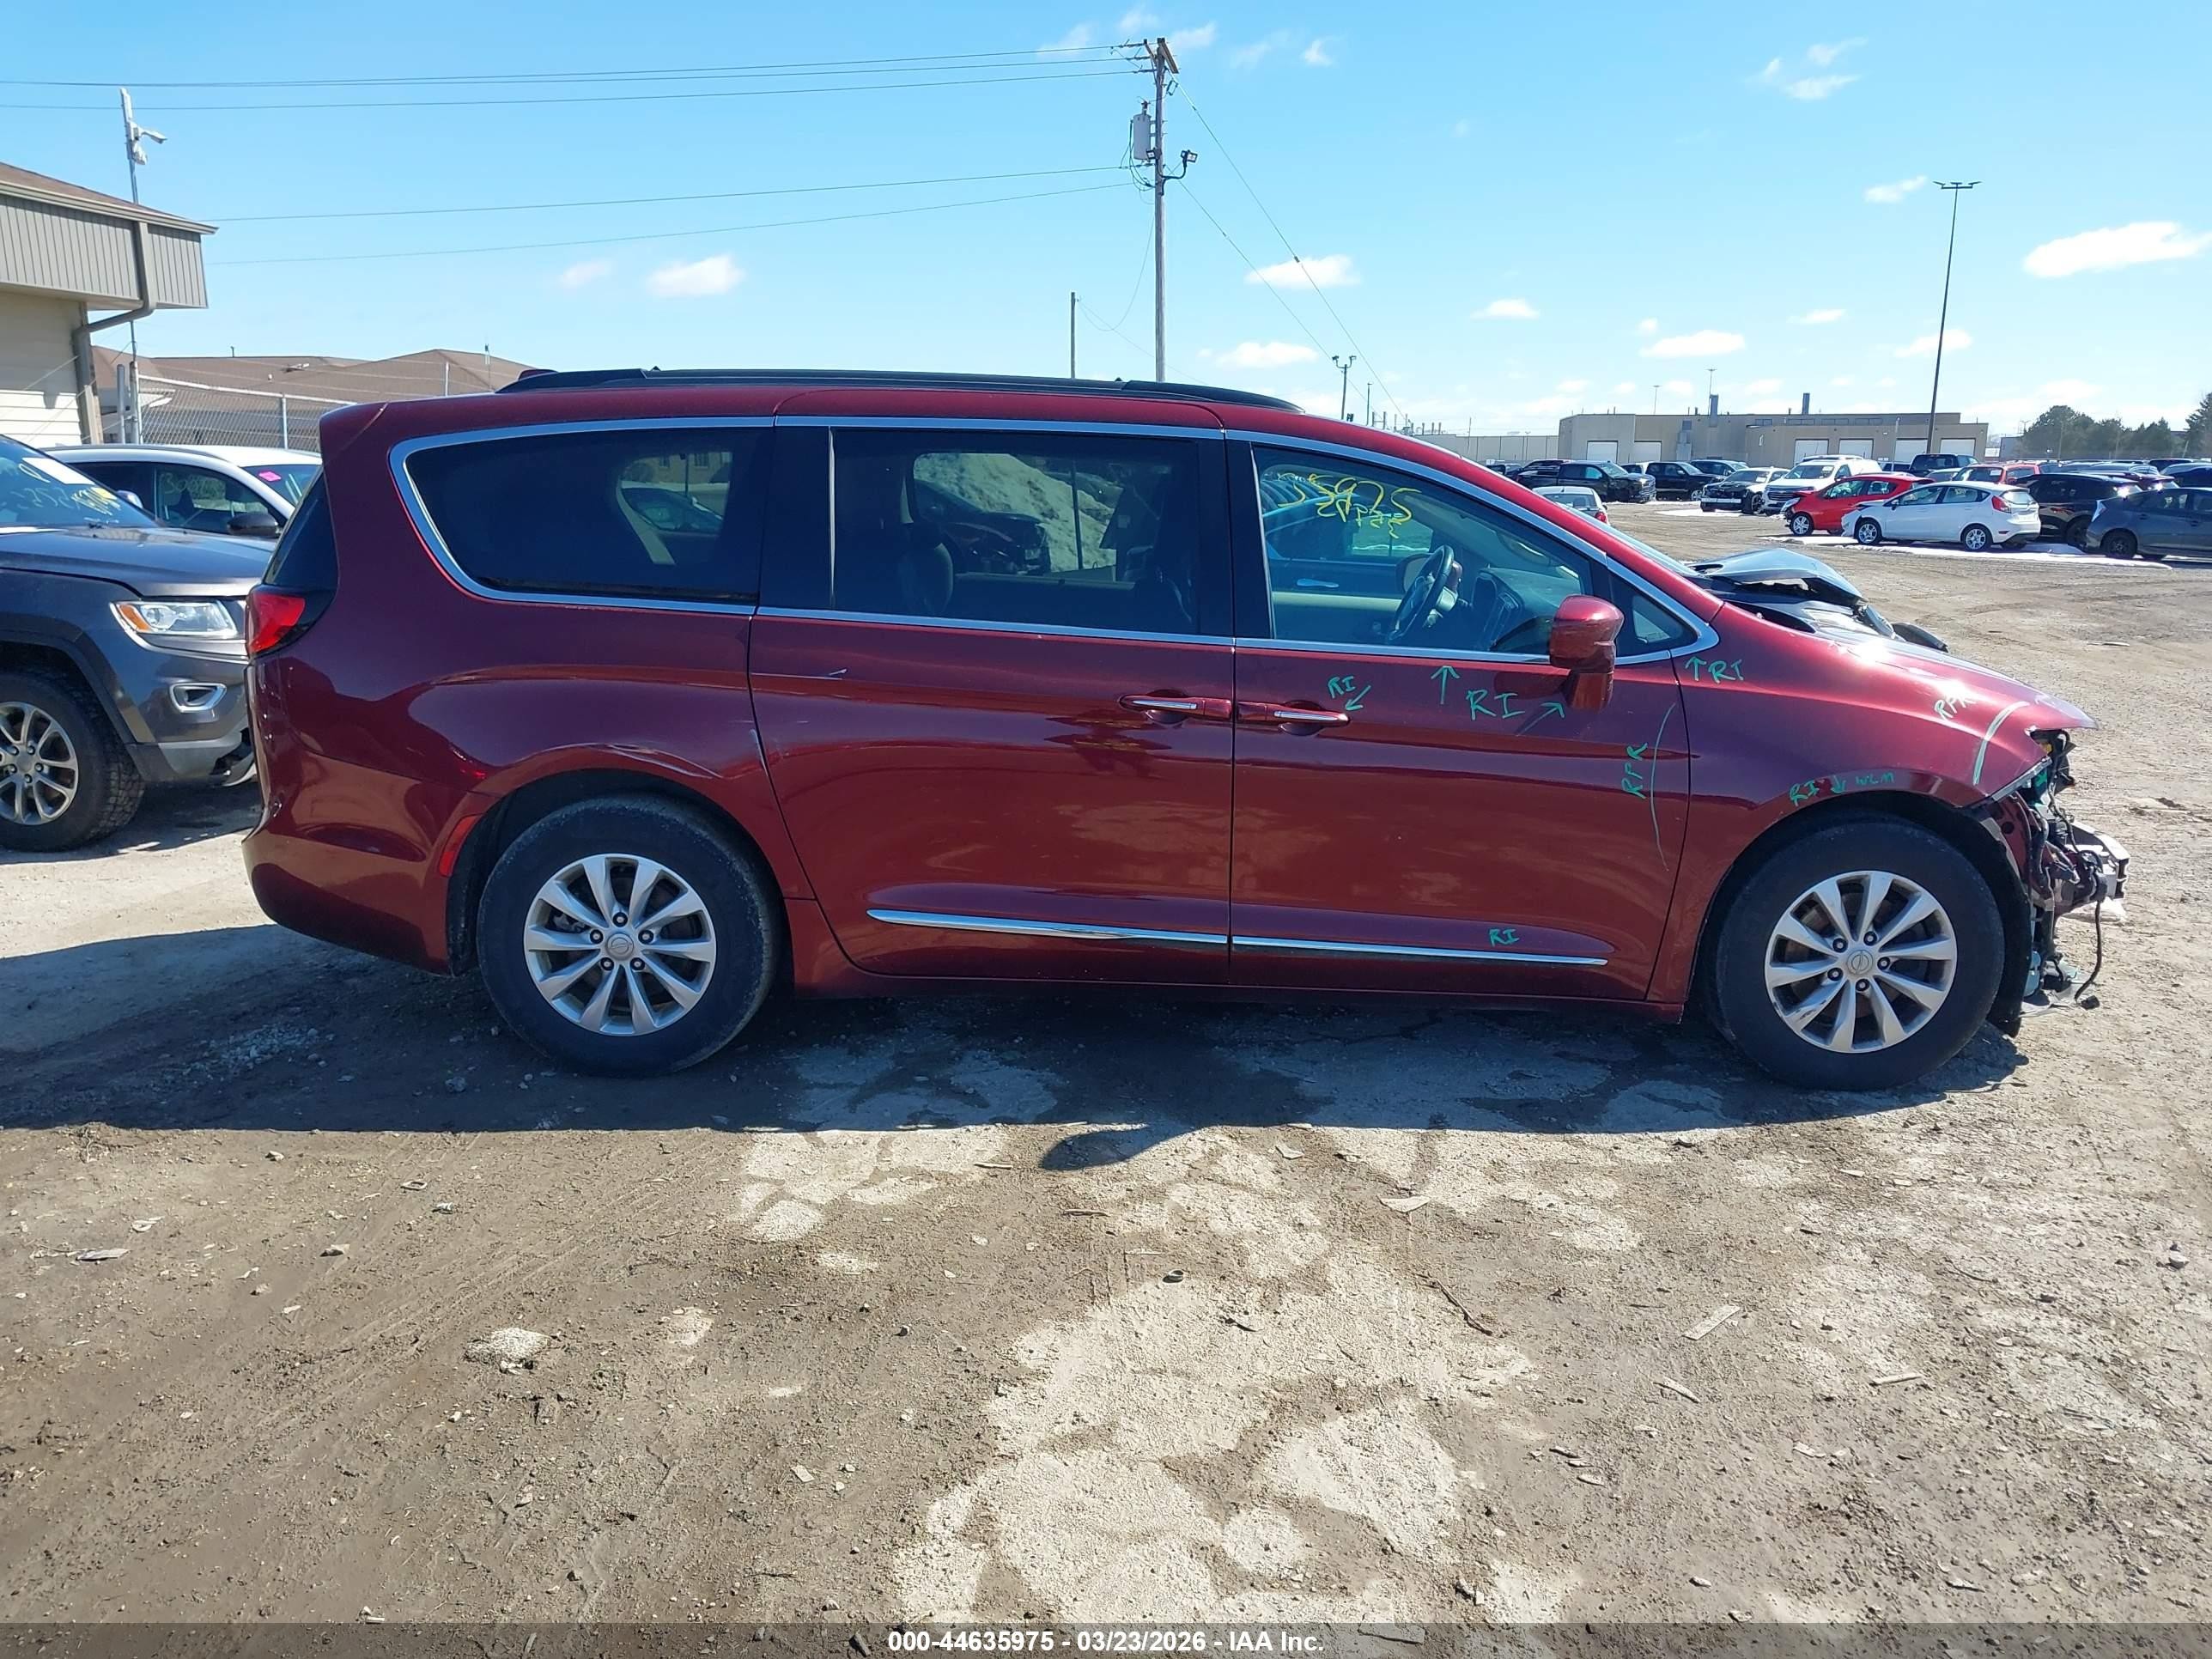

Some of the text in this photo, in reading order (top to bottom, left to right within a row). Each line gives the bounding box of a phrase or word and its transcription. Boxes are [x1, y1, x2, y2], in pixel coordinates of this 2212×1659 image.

[1327, 675, 1357, 699] RI
[1466, 689, 1526, 721] RI
[1489, 928, 1520, 947] RI
